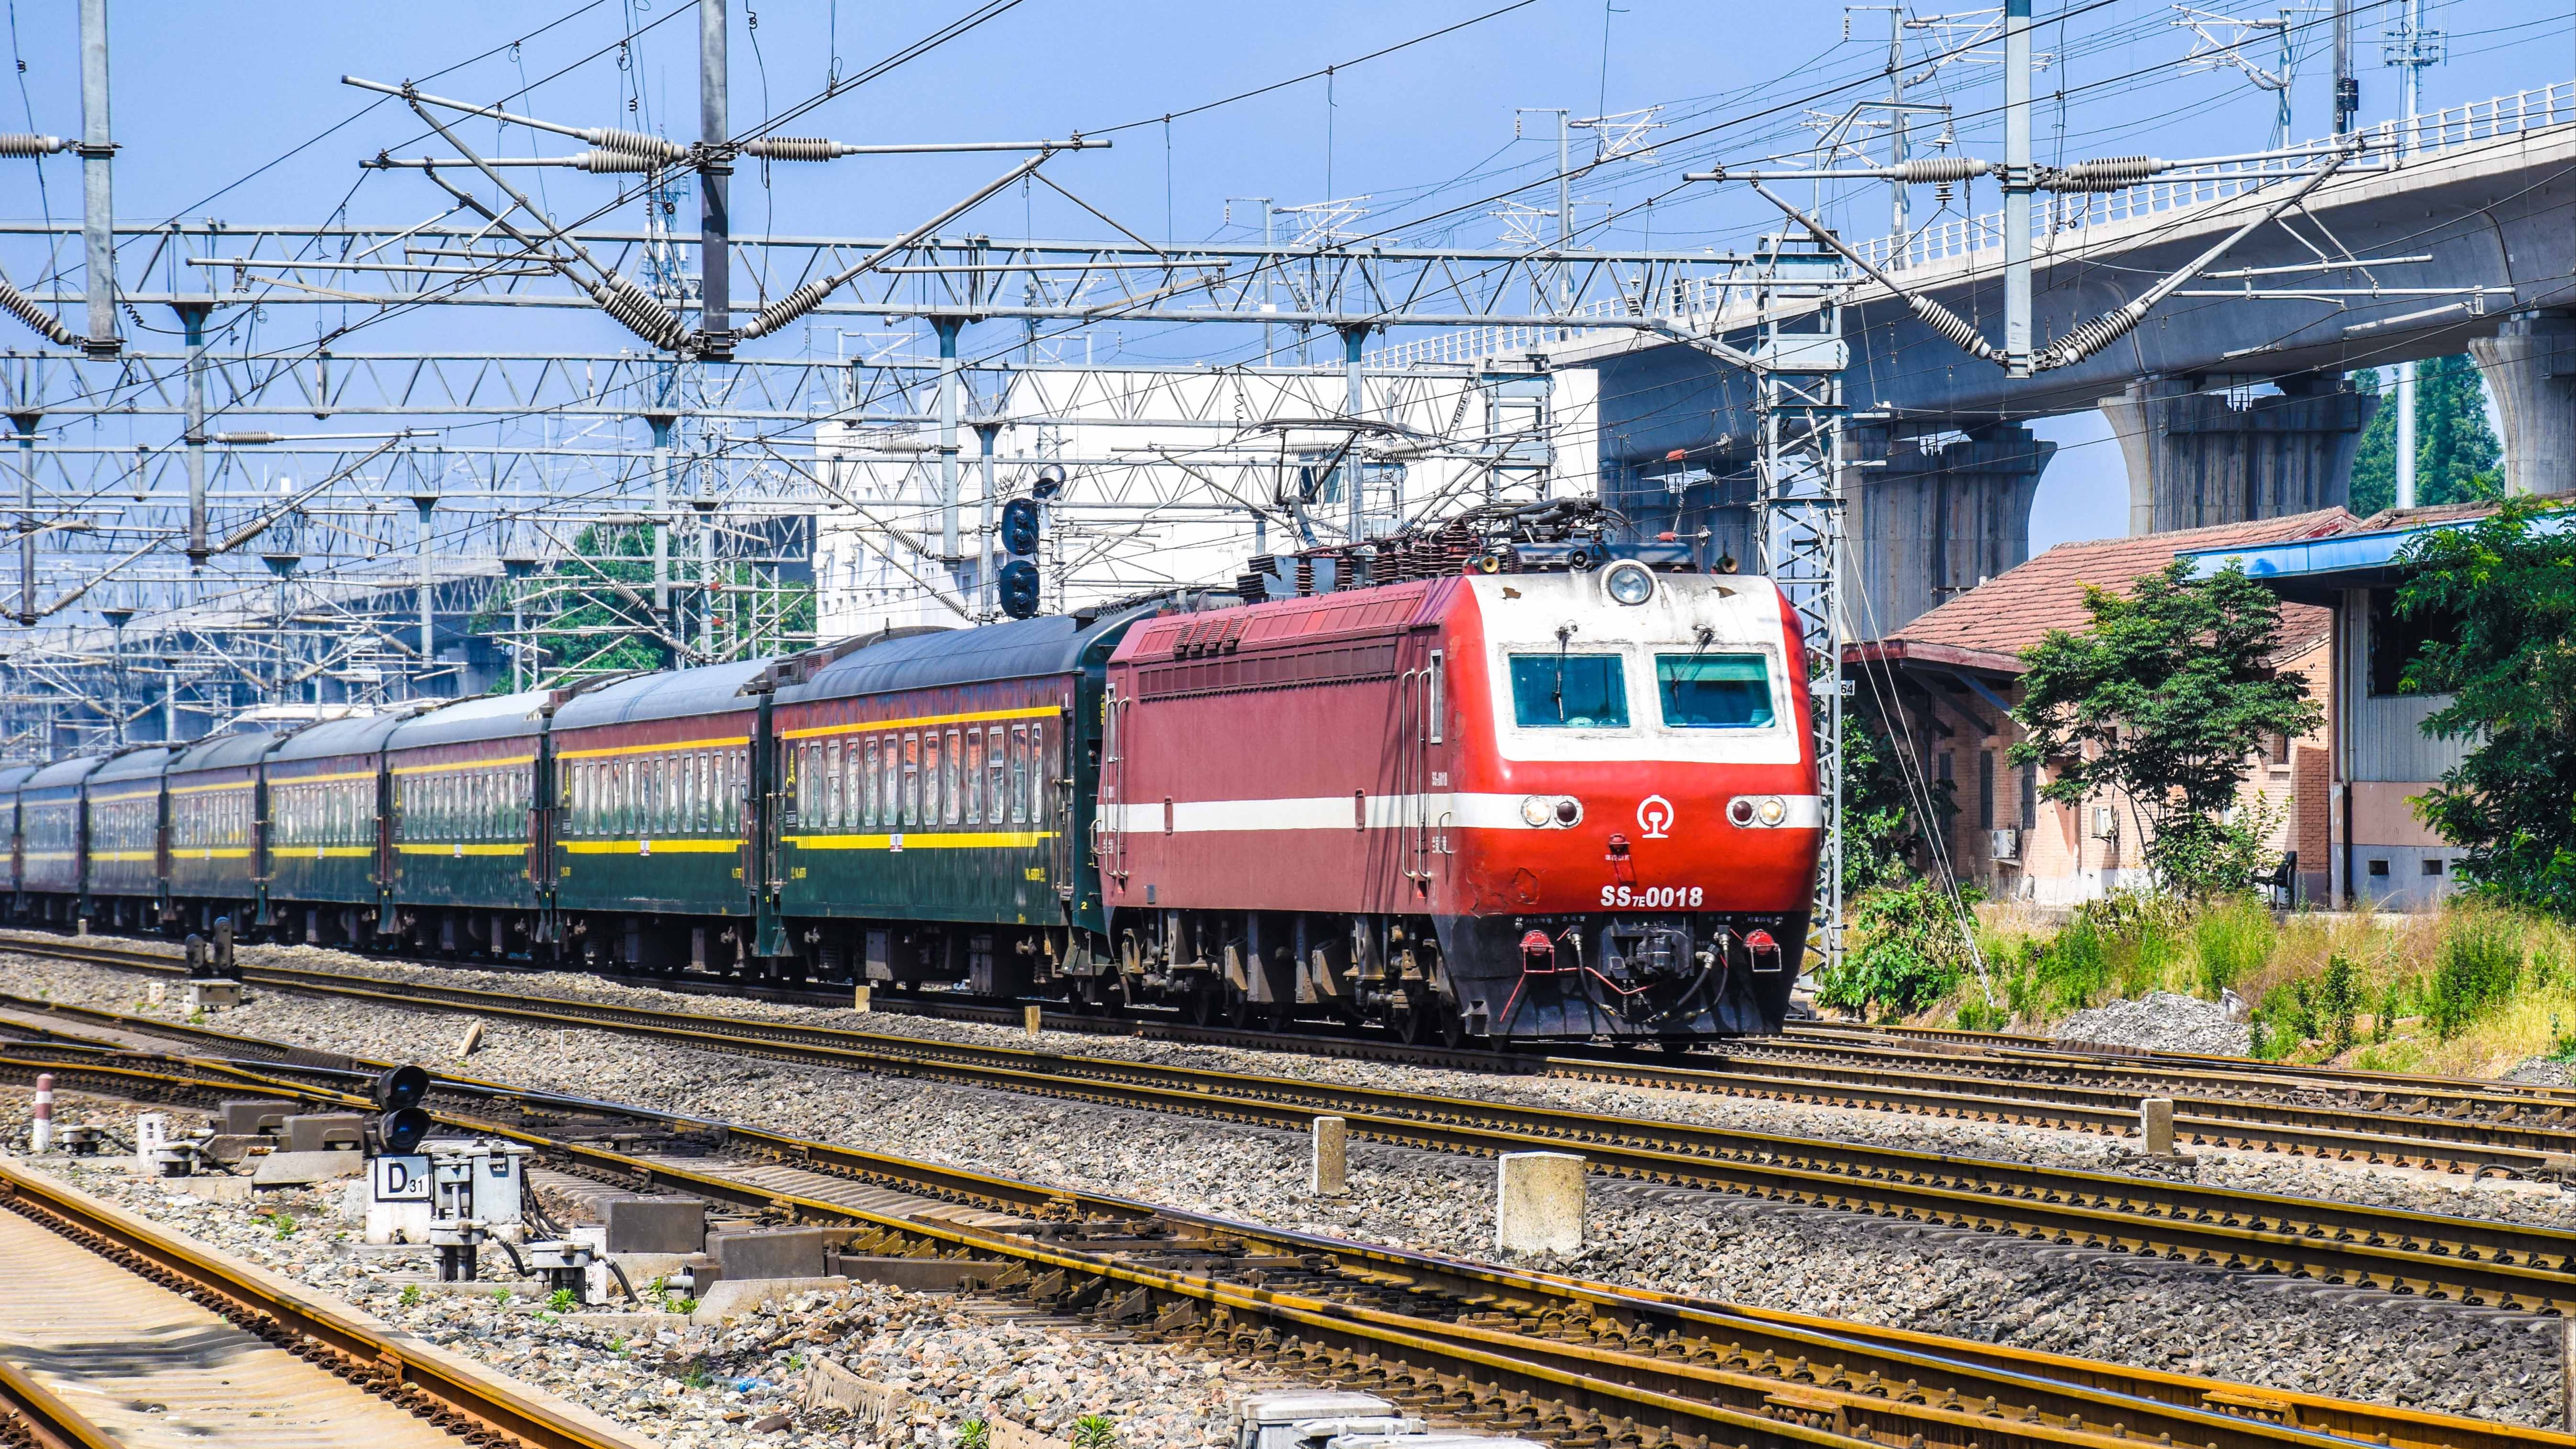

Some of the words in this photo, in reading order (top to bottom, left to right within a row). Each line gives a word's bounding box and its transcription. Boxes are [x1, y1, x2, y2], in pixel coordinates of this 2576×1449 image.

[1841, 684, 1853, 694] 64
[1600, 885, 1703, 907] SS7E0018
[1080, 901, 1088, 910] 2
[566, 1035, 574, 1046] 2
